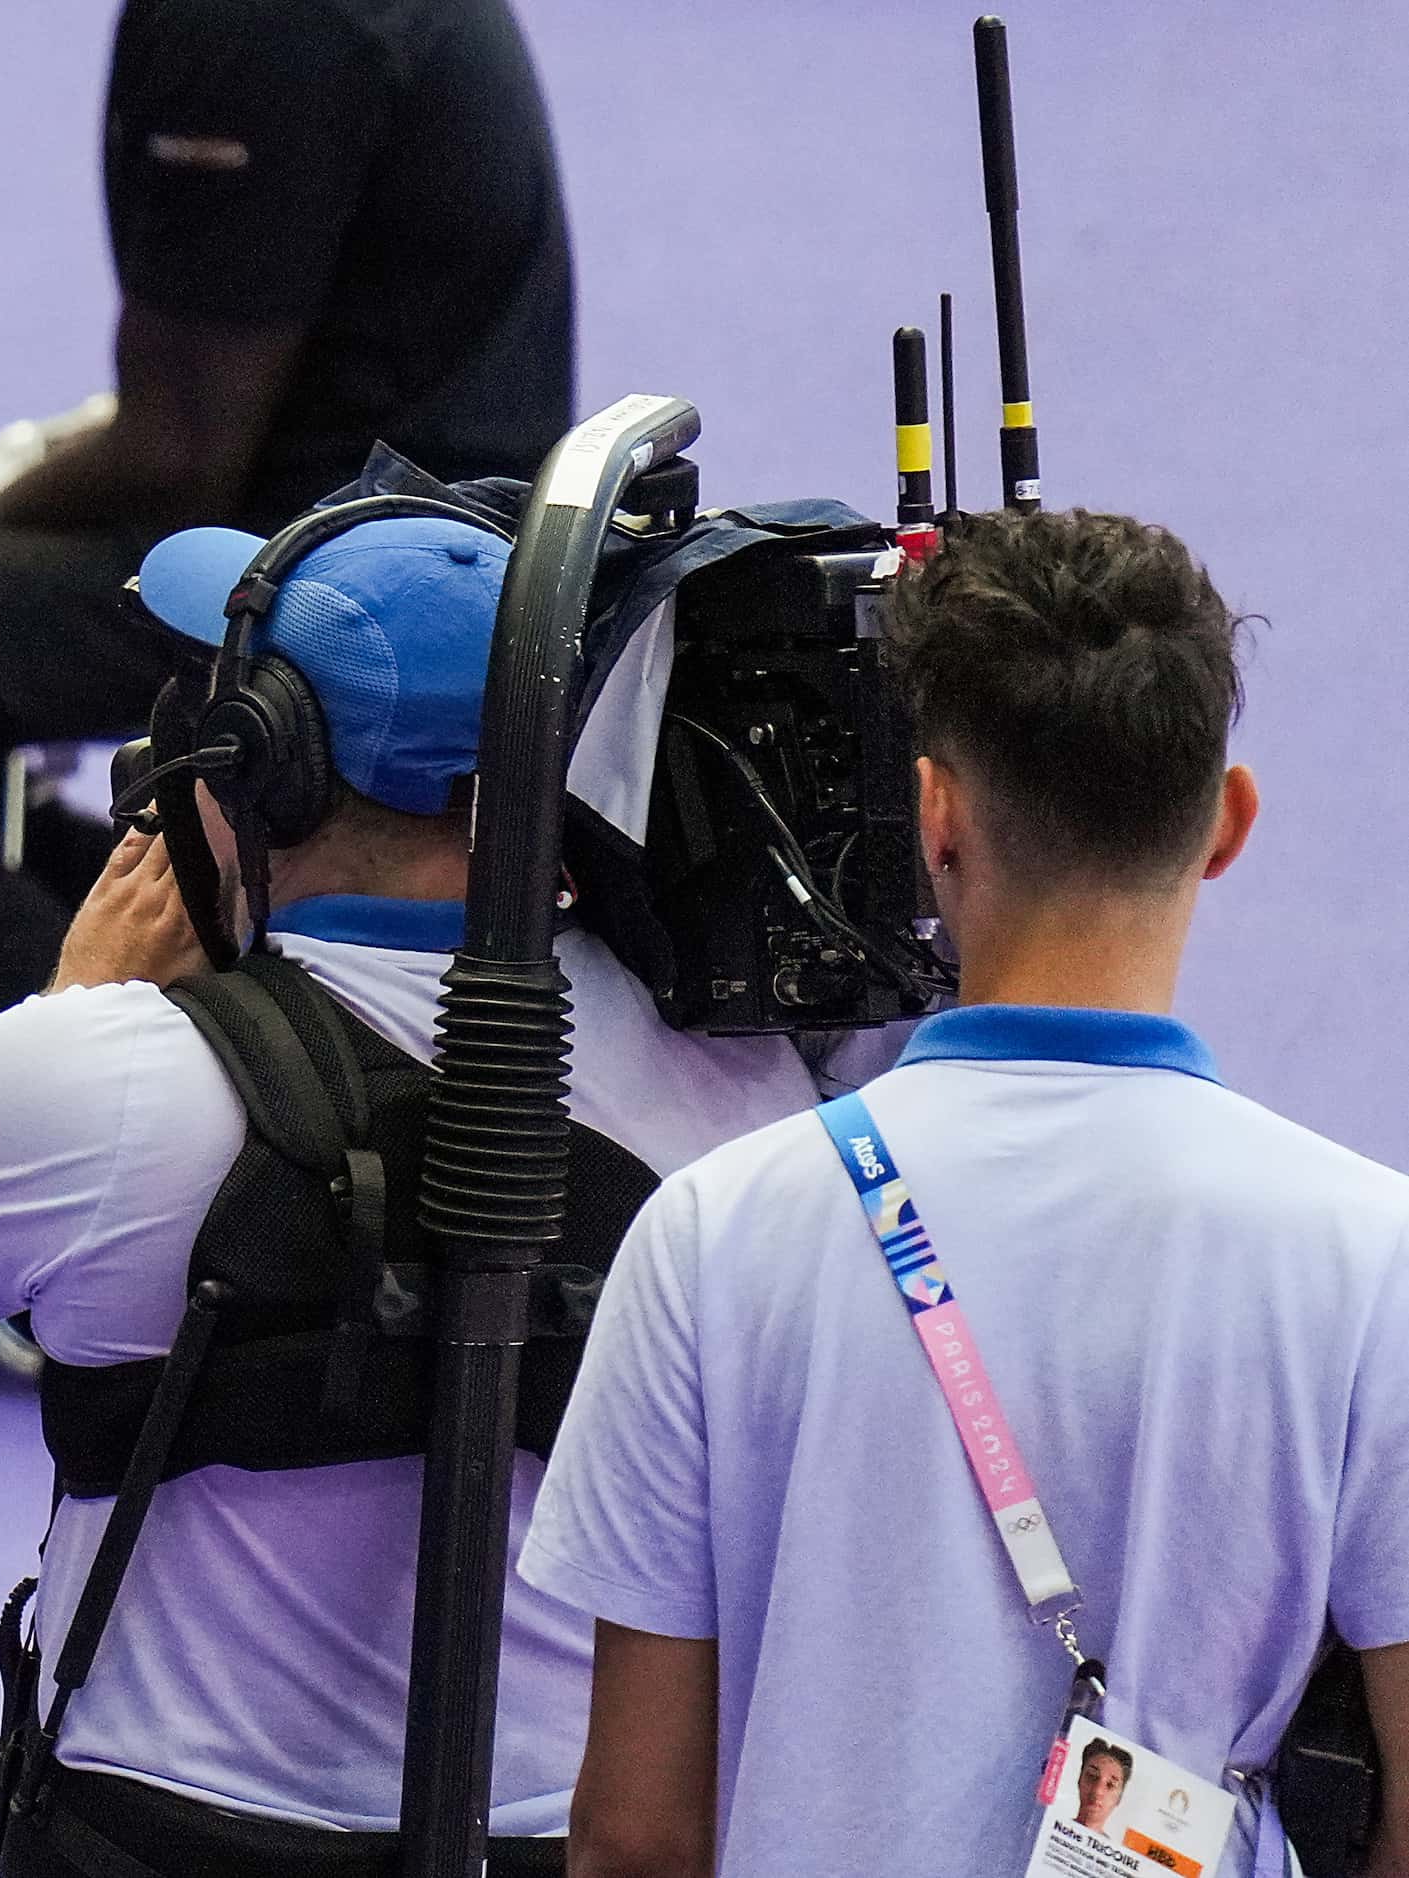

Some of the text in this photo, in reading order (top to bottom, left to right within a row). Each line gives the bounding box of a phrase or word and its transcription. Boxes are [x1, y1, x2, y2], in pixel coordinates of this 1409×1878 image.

[848, 1135, 885, 1180] Atos
[935, 1320, 1017, 1495] PARIS 2024
